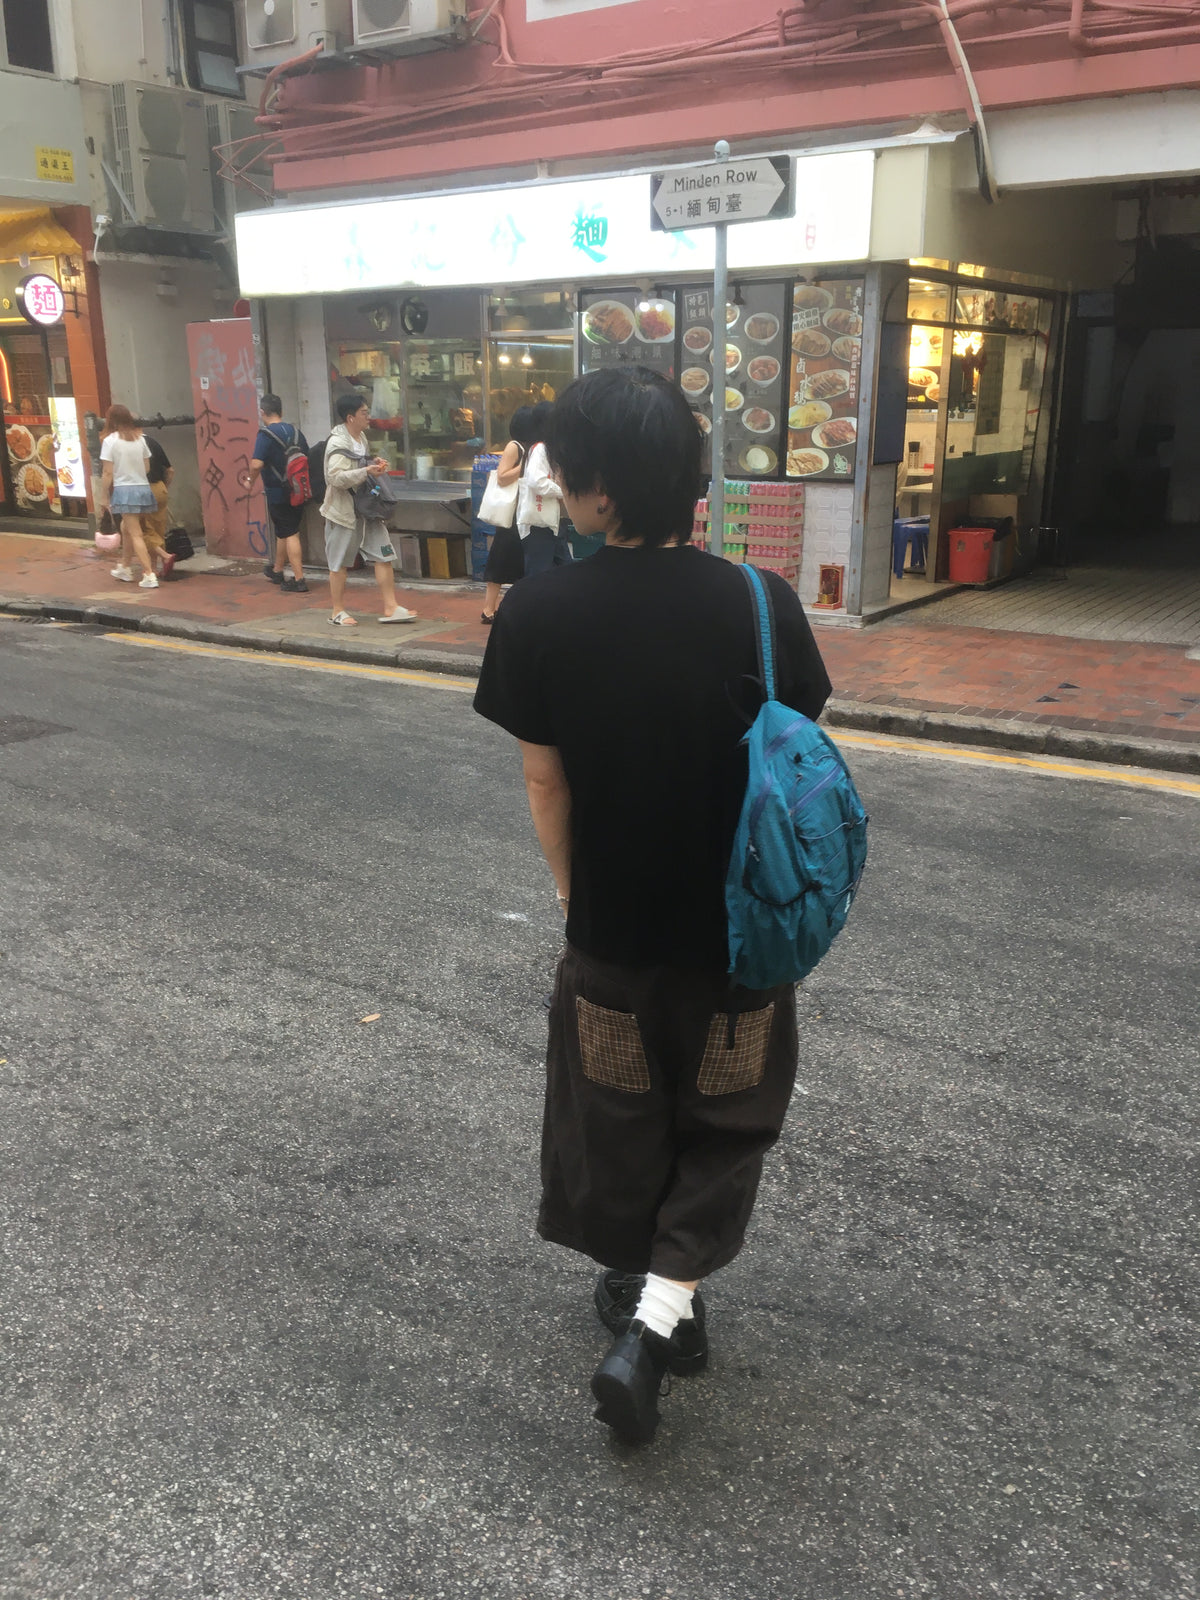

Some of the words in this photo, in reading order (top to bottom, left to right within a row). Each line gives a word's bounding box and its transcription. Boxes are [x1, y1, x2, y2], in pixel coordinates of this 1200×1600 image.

[674, 173, 720, 192] Minden
[726, 169, 758, 183] Row
[687, 193, 742, 218] 緬甸臺
